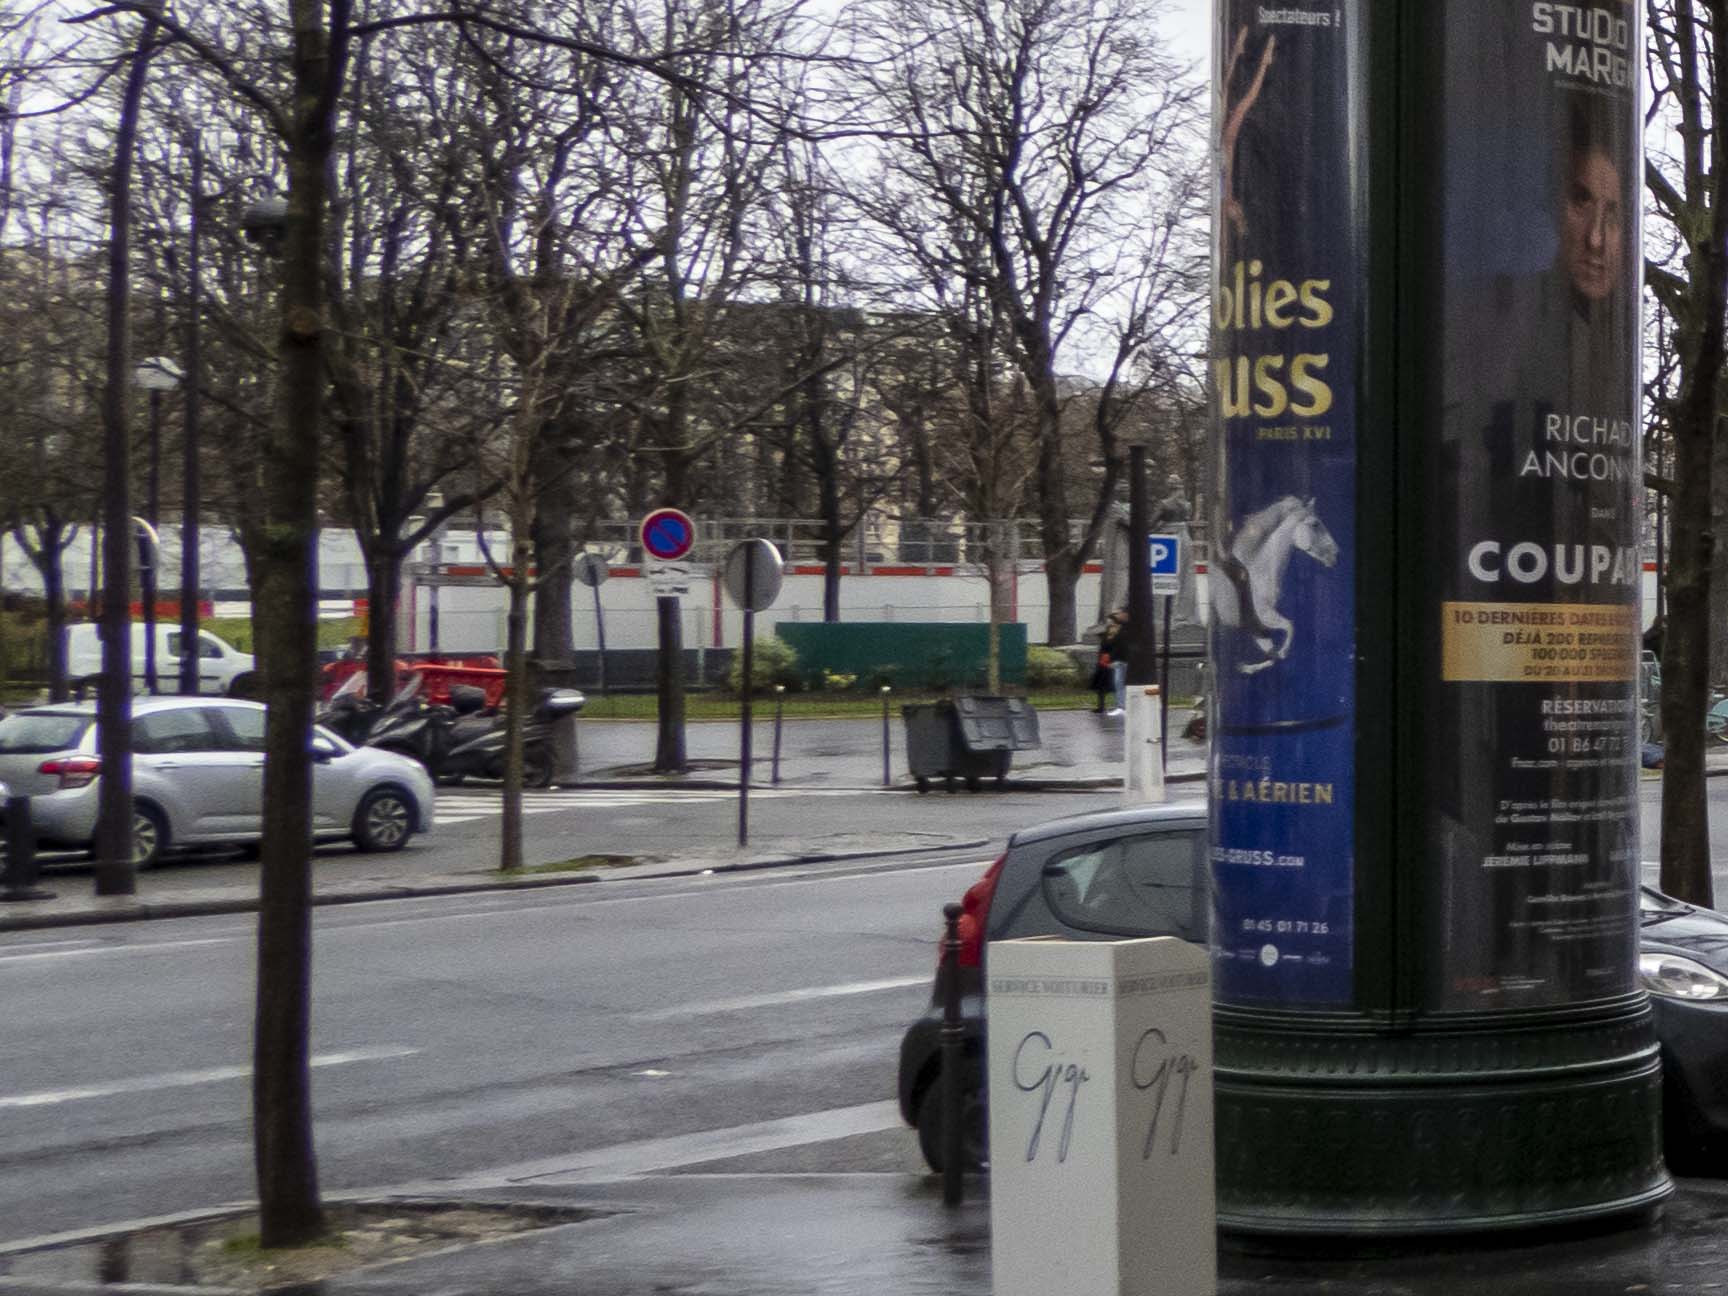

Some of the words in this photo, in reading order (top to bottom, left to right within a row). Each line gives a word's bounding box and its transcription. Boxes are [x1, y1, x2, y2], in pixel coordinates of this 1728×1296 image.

[1256, 426, 1298, 441] PARIS
[1303, 426, 1331, 441] XVI
[1242, 776, 1333, 804] AÉRIEN
